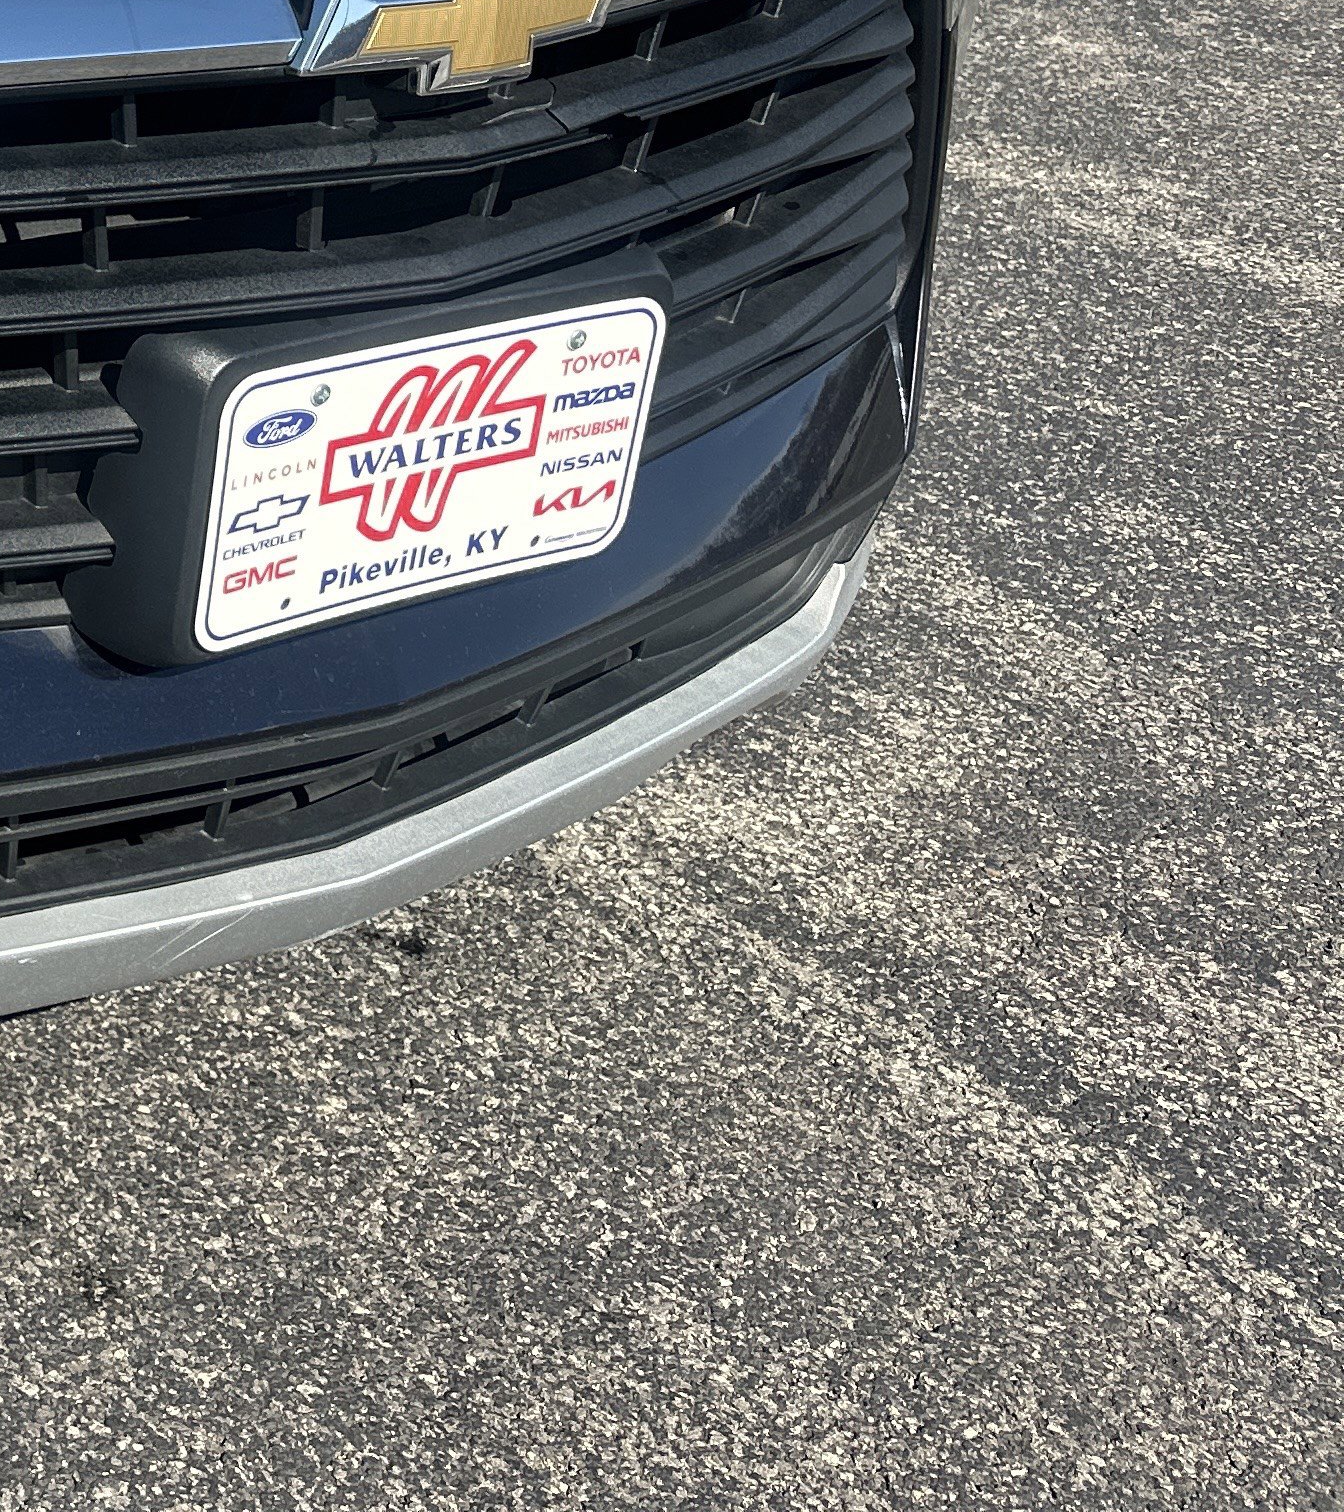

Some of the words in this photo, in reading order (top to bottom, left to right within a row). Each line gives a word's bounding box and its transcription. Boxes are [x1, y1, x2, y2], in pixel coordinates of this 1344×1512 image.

[562, 347, 641, 377] TOYOTA
[546, 416, 630, 445] MITSUBISHI
[349, 417, 522, 479] WALTERS
[540, 447, 623, 477] NISSAN
[230, 458, 317, 491] LINCOLN
[222, 528, 307, 561] CHEVROLET
[318, 544, 452, 595] Pikeville,
[465, 524, 510, 557] KY
[222, 554, 298, 595] GMC
